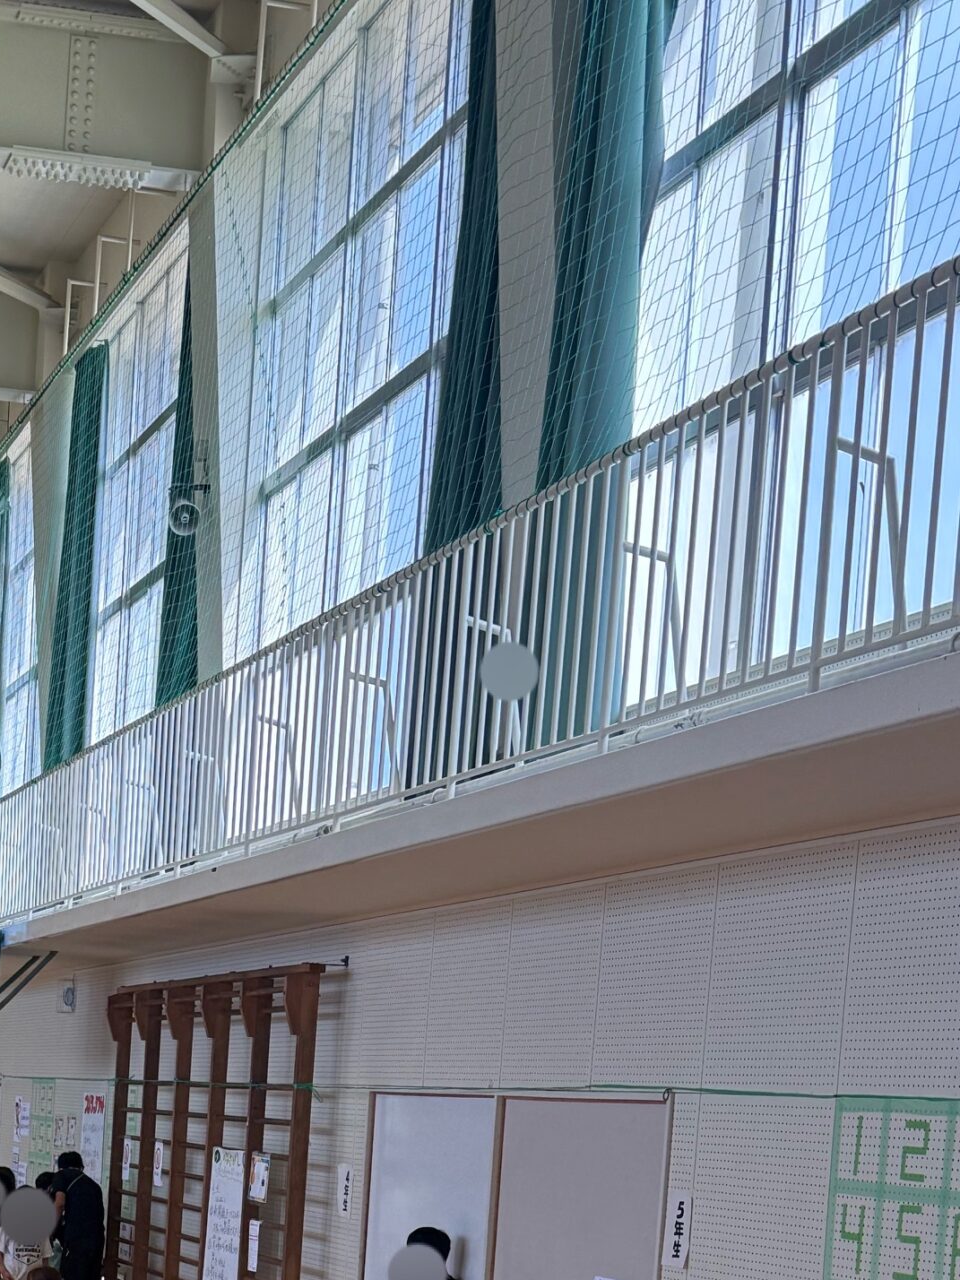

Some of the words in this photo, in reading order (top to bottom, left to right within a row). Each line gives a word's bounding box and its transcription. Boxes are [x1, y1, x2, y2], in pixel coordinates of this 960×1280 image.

[852, 1115, 864, 1176] 1
[899, 1119, 931, 1182] 2
[671, 1201, 685, 1259] 5年生
[840, 1203, 866, 1275] 4
